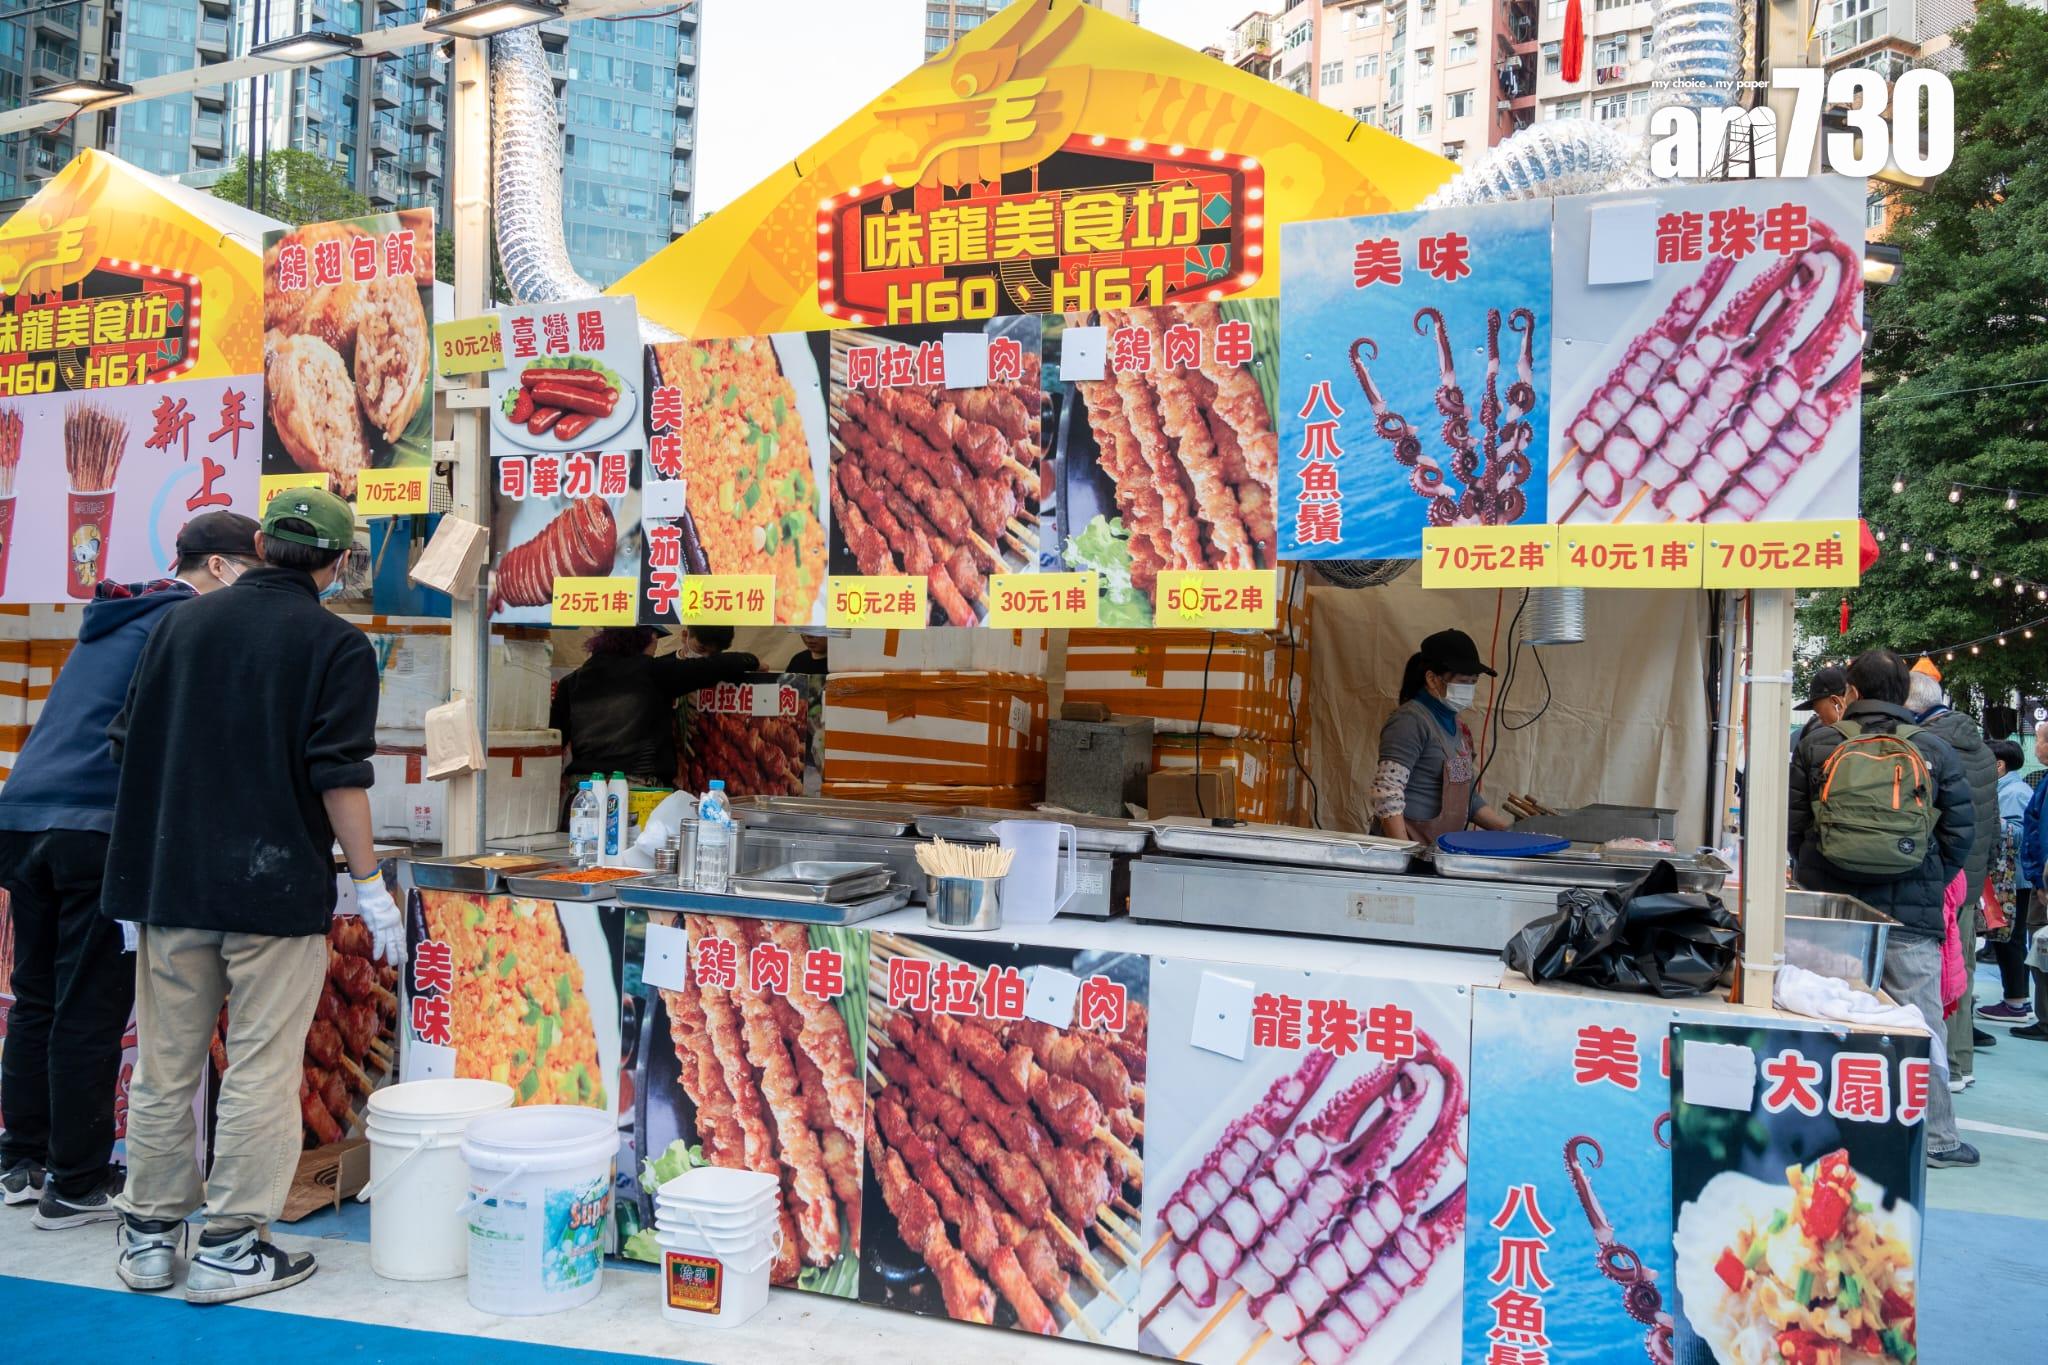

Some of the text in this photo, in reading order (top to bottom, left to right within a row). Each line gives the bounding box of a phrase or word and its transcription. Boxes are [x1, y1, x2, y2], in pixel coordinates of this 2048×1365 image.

[864, 188, 1201, 268] 味龍美食坊
[1655, 202, 1810, 265] 龍珠串
[1353, 231, 1470, 288] 美味
[510, 310, 606, 359] 臺灣腸
[501, 453, 628, 498] 司華力腸
[1296, 380, 1344, 544] 八爪魚鬚
[364, 480, 422, 502] 70元2個
[1435, 541, 1545, 571] 70元2串
[1570, 541, 1689, 571] 40元1串
[1719, 538, 1844, 570] 70元2串
[559, 589, 629, 614] 25元1串
[688, 588, 766, 612] 25元1份
[836, 588, 917, 616] 50元2串
[999, 587, 1087, 614] 30元1串
[1167, 586, 1264, 614] 50元2串
[413, 940, 452, 1045] 美味
[1251, 993, 1415, 1061] 龍珠串
[1574, 1025, 1670, 1089] 美
